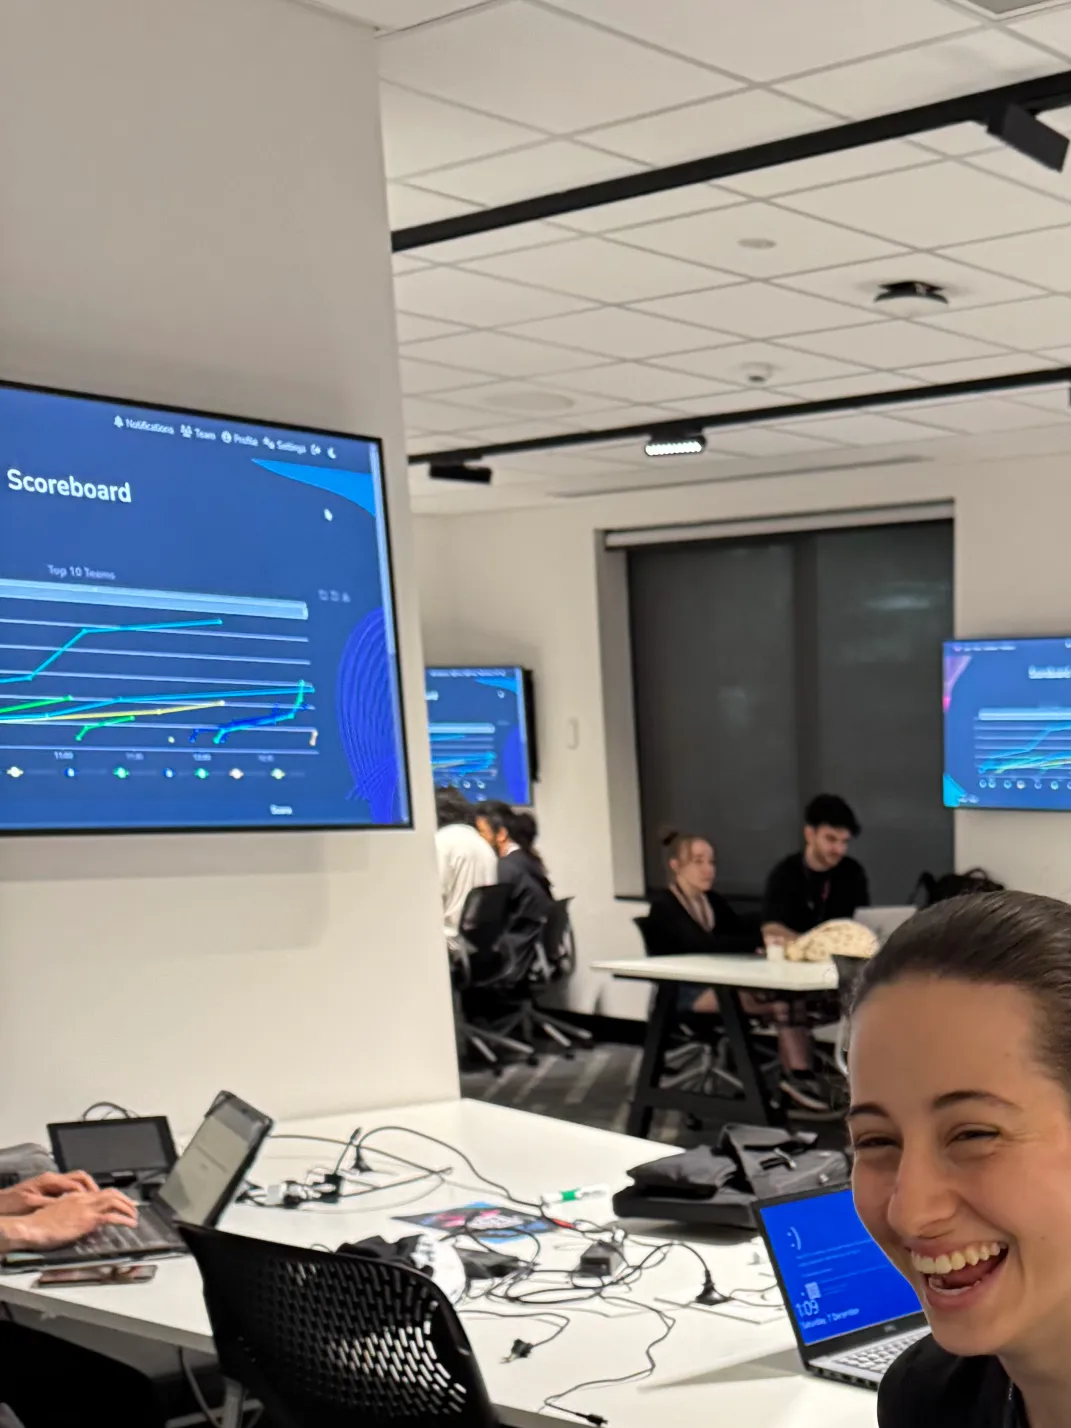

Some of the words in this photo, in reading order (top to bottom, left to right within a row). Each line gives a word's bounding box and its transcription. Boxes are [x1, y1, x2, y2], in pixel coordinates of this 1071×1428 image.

[125, 418, 175, 435] Notifications
[194, 428, 217, 440] Team
[233, 433, 259, 447] Profile
[276, 439, 307, 455] Settings
[6, 468, 132, 503] Scoreboard
[48, 564, 68, 578] Top
[69, 566, 83, 577] 10
[84, 567, 116, 581] Teams
